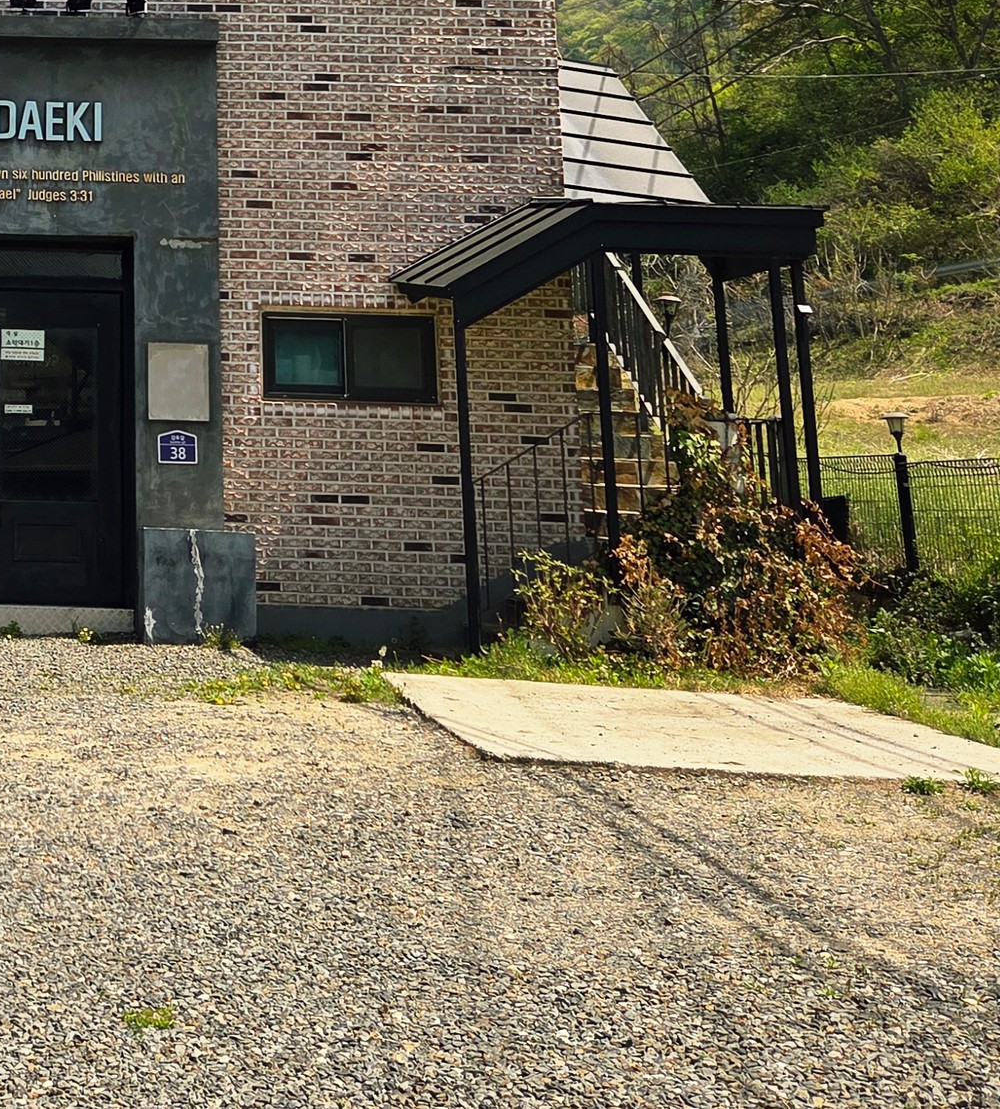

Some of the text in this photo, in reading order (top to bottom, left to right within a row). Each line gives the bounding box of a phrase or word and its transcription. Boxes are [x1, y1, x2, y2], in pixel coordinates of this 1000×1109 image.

[12, 169, 28, 180] six
[31, 169, 79, 182] hundred
[82, 170, 140, 183] Philistines
[143, 172, 168, 184] with
[170, 173, 186, 184] an
[27, 189, 67, 202] Judges
[69, 190, 94, 202] 3:31
[170, 446, 187, 460] 38
